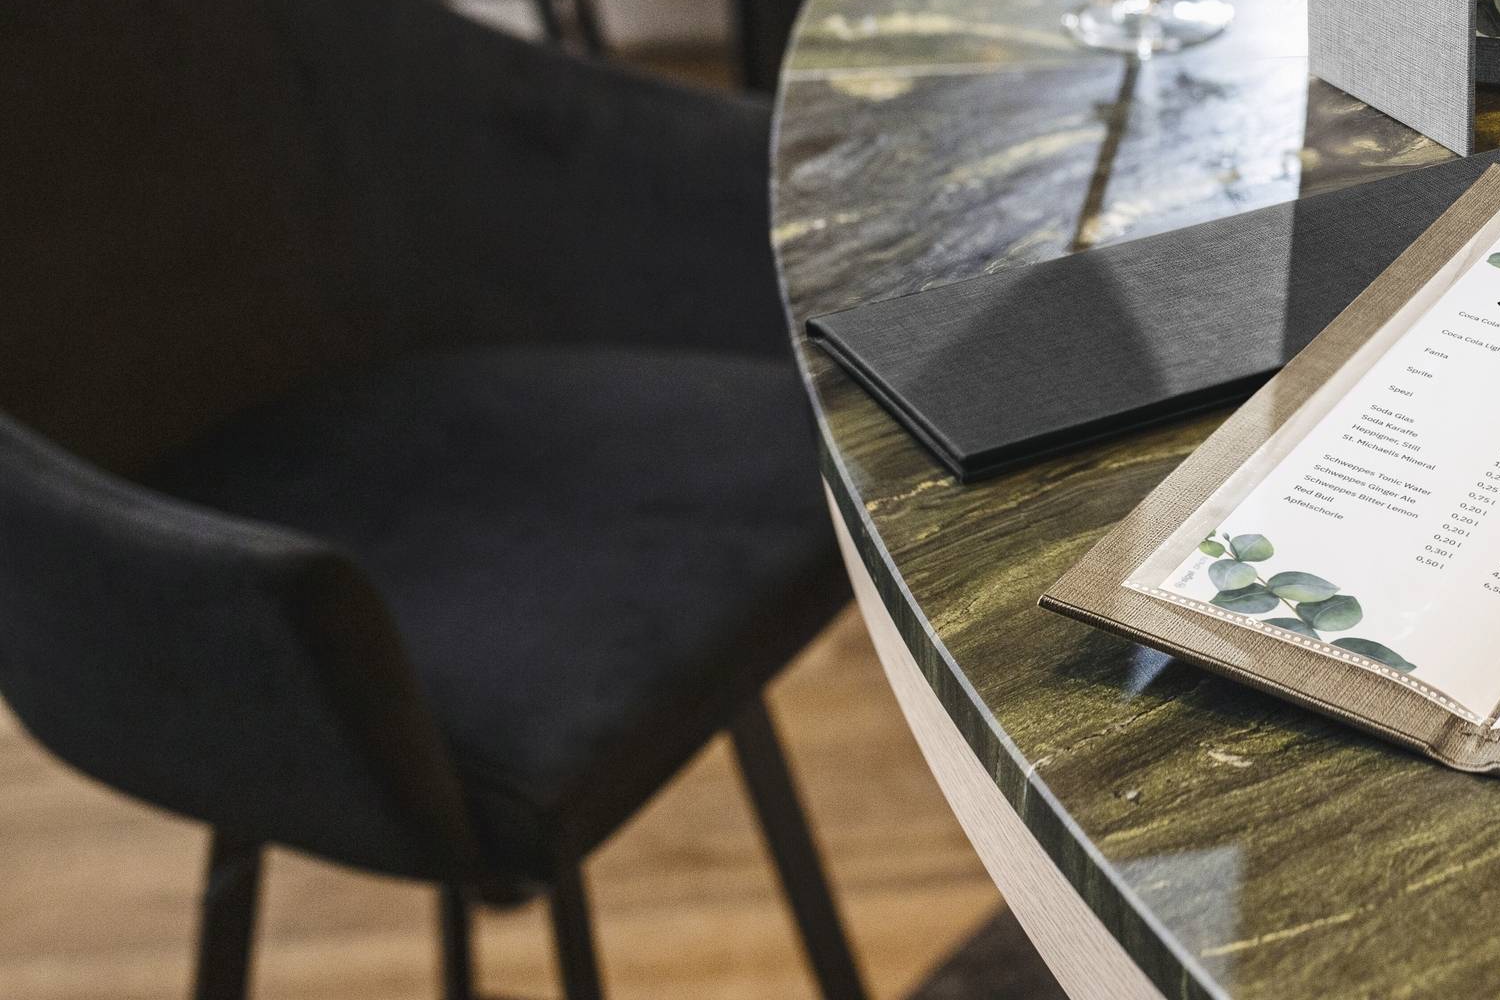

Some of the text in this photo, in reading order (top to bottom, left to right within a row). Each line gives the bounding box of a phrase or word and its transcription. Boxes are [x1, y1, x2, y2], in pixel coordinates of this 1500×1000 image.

[1458, 311, 1480, 321] Coca
[1481, 318, 1500, 328] Cola
[1441, 329, 1463, 340] Coca
[1464, 336, 1484, 346] Cola
[1424, 347, 1449, 360] Fanta
[1406, 366, 1433, 379] Sprite
[1388, 384, 1414, 397] Spezi
[1370, 404, 1393, 416] Soda
[1394, 413, 1414, 424] Glas
[1361, 414, 1384, 426] Soda
[1385, 422, 1418, 438] Karaffe
[1401, 441, 1422, 452] Still
[1356, 438, 1400, 458] Michaelis
[1400, 454, 1436, 471] Mineral
[1476, 481, 1499, 493] 0,25
[1323, 454, 1376, 476] Schweppes
[1378, 473, 1403, 486] Tonic
[1404, 482, 1431, 496] Water
[1459, 502, 1482, 514] 0,20
[1313, 464, 1367, 487] Schweppes
[1368, 483, 1400, 498] Ginger
[1399, 495, 1416, 504] Ale
[1451, 512, 1474, 525] 0,20
[1468, 492, 1491, 504] 0,75
[1303, 474, 1357, 497] Schweppes
[1358, 493, 1385, 507] Bitter
[1386, 503, 1419, 519] Lemon
[1442, 523, 1465, 535] 0,20
[1293, 484, 1315, 497] Red
[1314, 492, 1335, 503] Bull
[1433, 534, 1457, 546] 0,20
[1283, 495, 1344, 520] Apfelschorle
[1424, 544, 1448, 557] 0,30
[1415, 555, 1439, 568] 0,50
